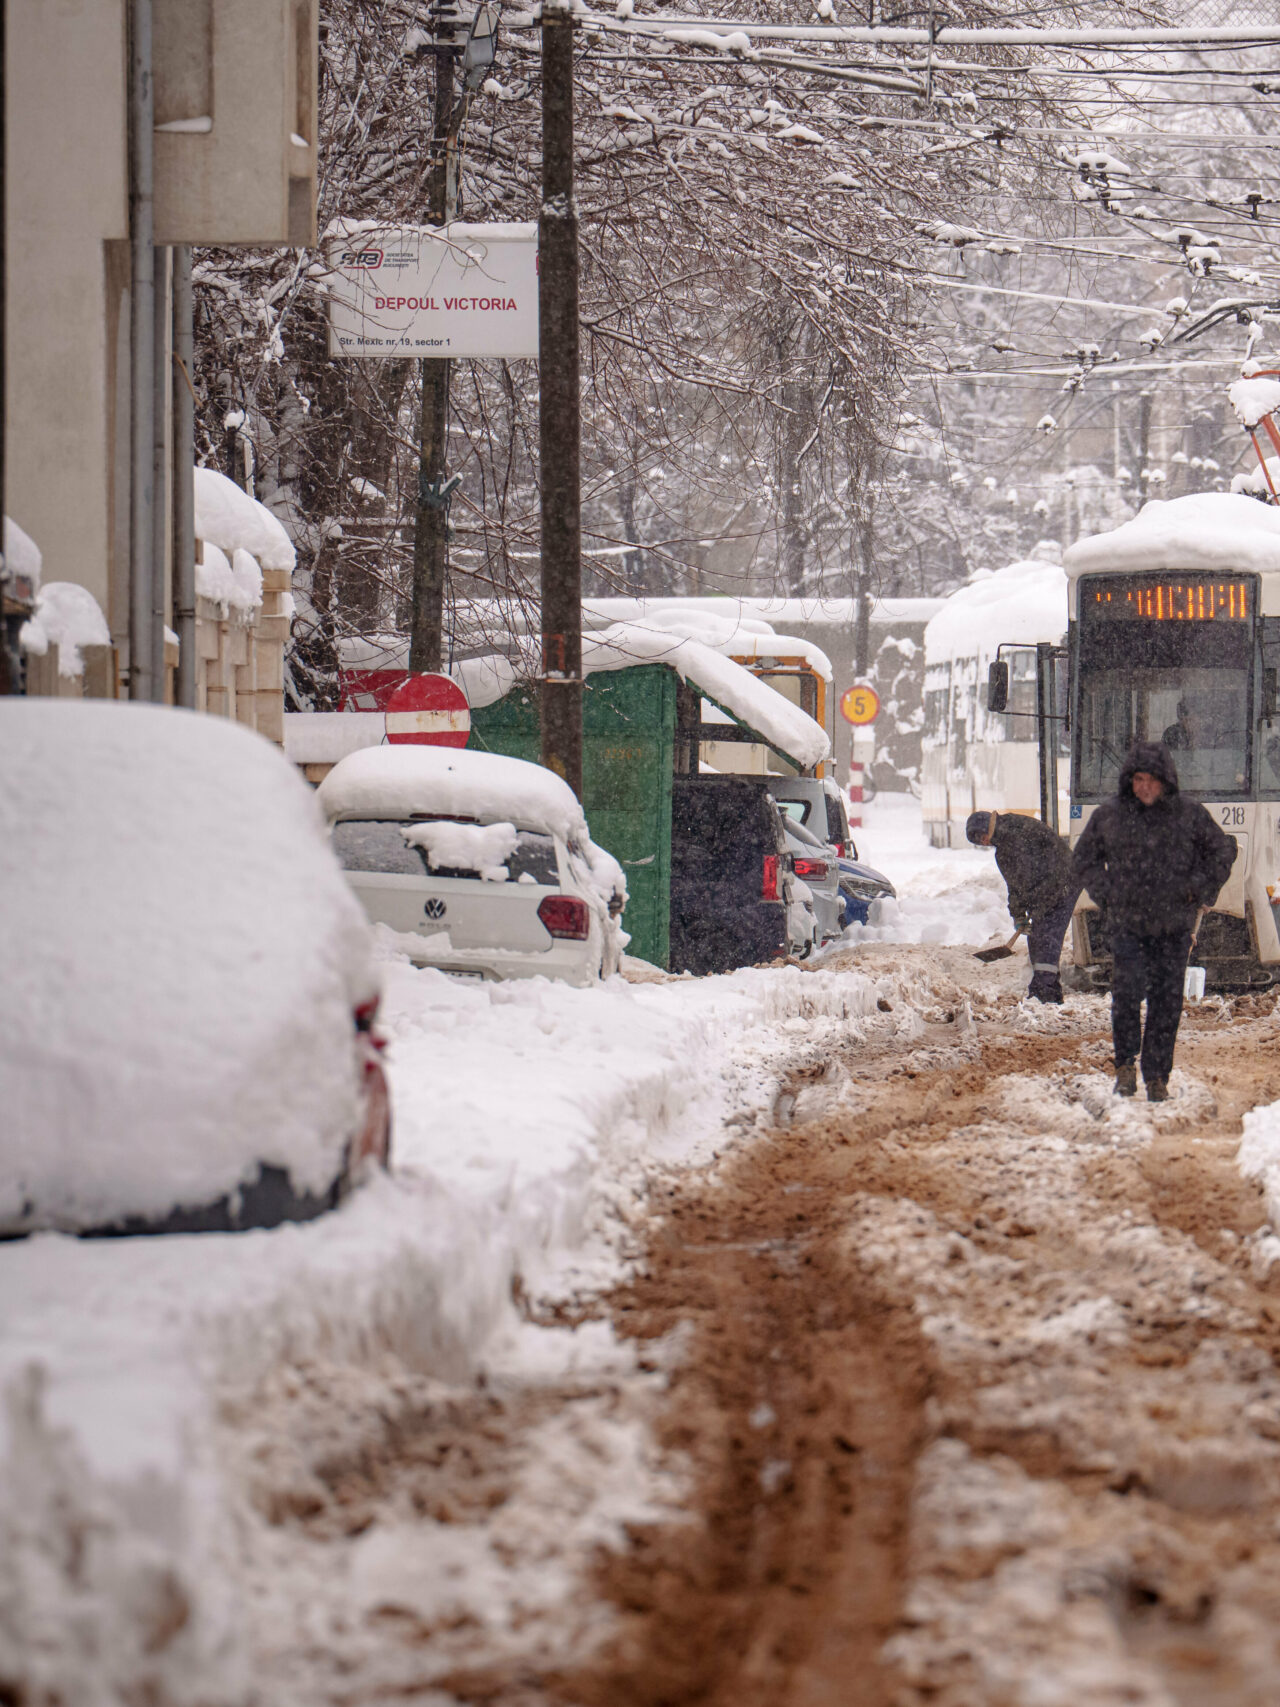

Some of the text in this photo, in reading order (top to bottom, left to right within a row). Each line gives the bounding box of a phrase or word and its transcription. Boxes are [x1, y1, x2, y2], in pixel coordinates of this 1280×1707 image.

[375, 297, 517, 311] DEPOUL VICTORIA
[339, 337, 355, 346] Str.
[357, 337, 383, 346] Mexic
[415, 338, 444, 346] sector
[446, 338, 451, 346] 1
[855, 696, 865, 716] 5
[1222, 806, 1245, 826] 218
